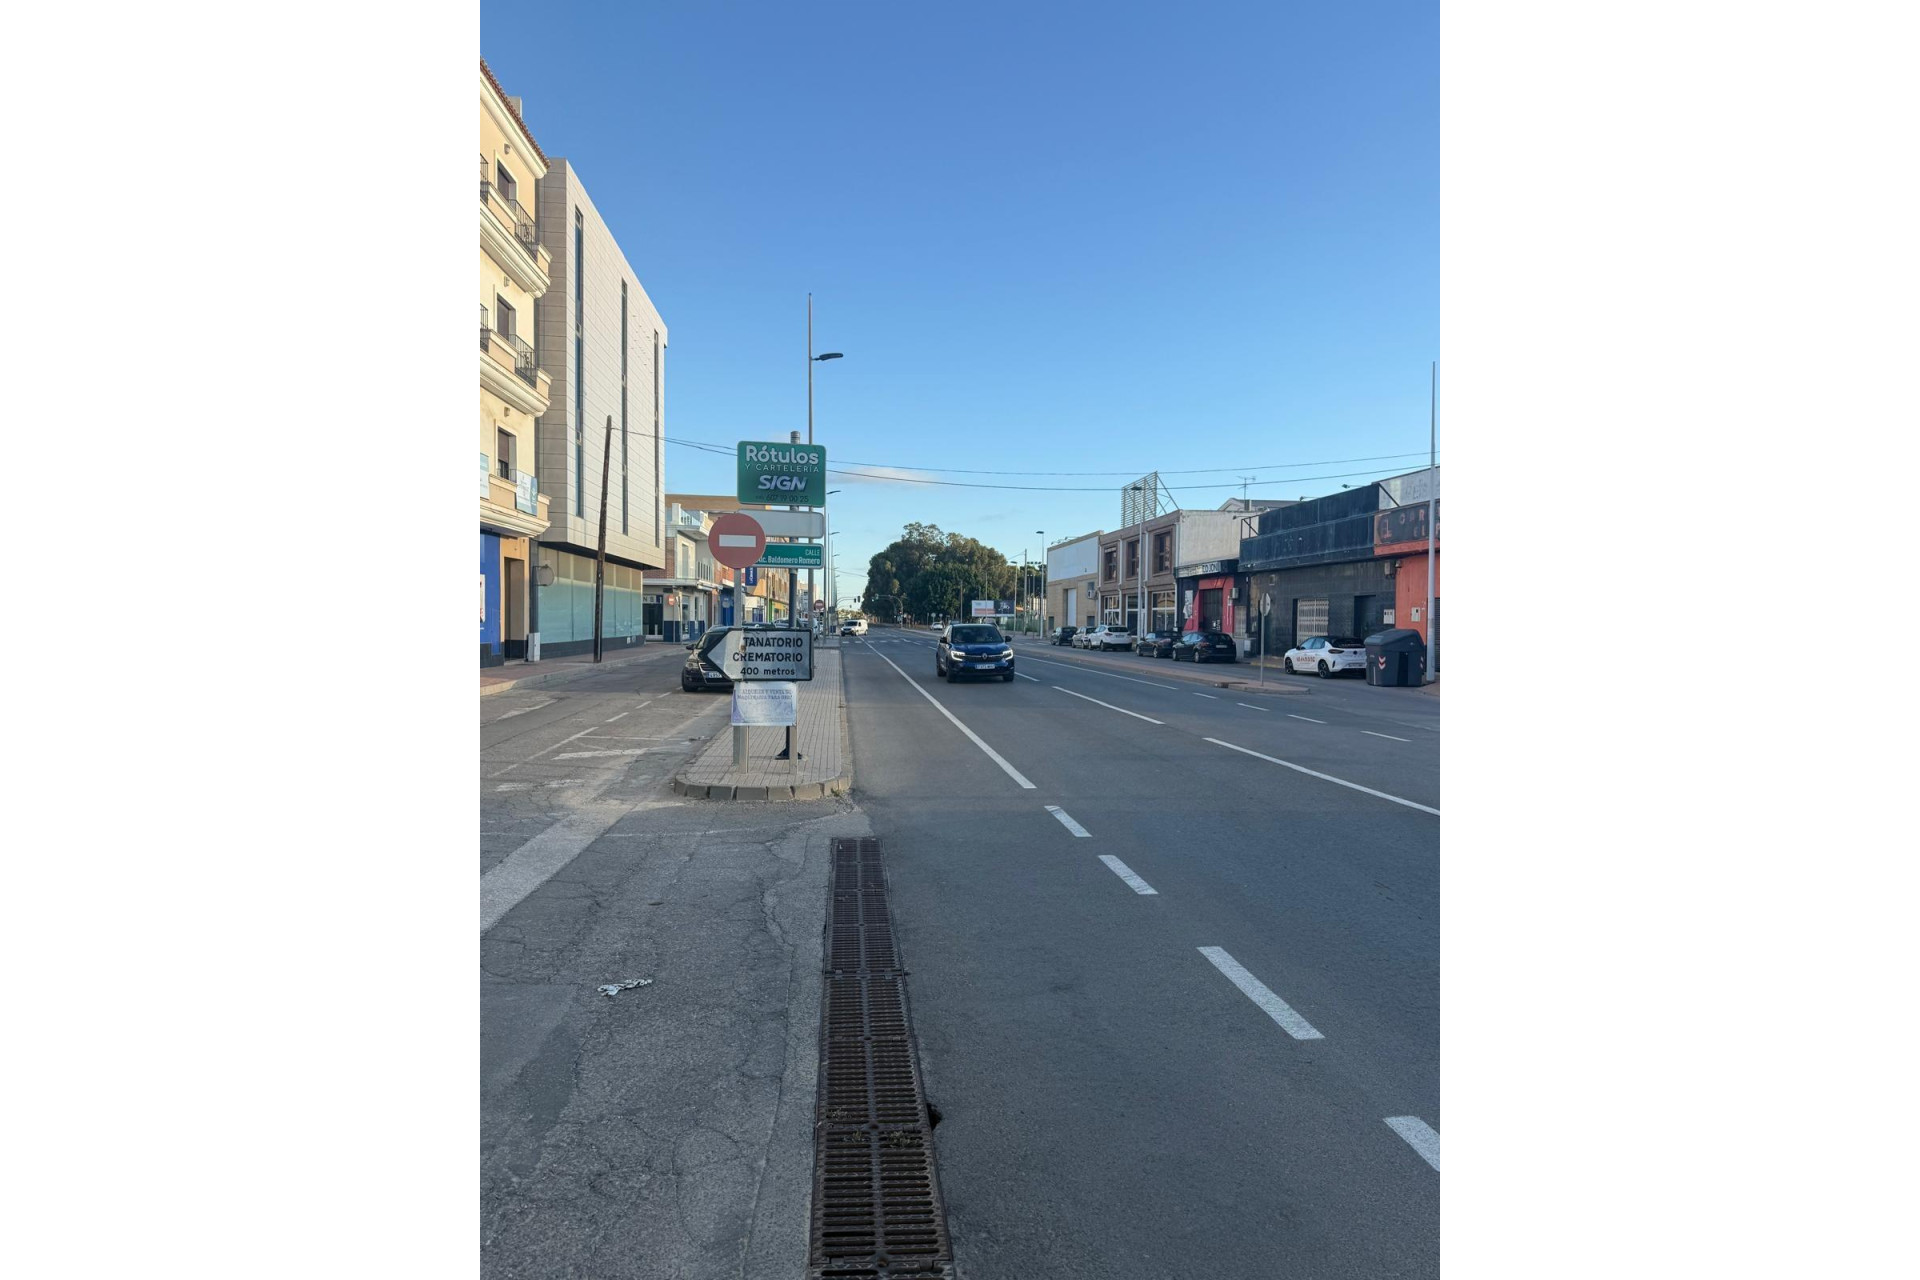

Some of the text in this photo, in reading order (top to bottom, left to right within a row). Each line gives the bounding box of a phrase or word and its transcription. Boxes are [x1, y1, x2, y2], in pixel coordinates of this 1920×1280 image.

[746, 445, 819, 464] Rótulos
[756, 464, 819, 472] CARTELERÍA
[758, 475, 806, 490] SIGN
[768, 556, 798, 564] Baldomero
[744, 638, 803, 647] TANATORIO
[733, 652, 803, 662] CREMATORIO
[740, 667, 795, 676] 400 metros
